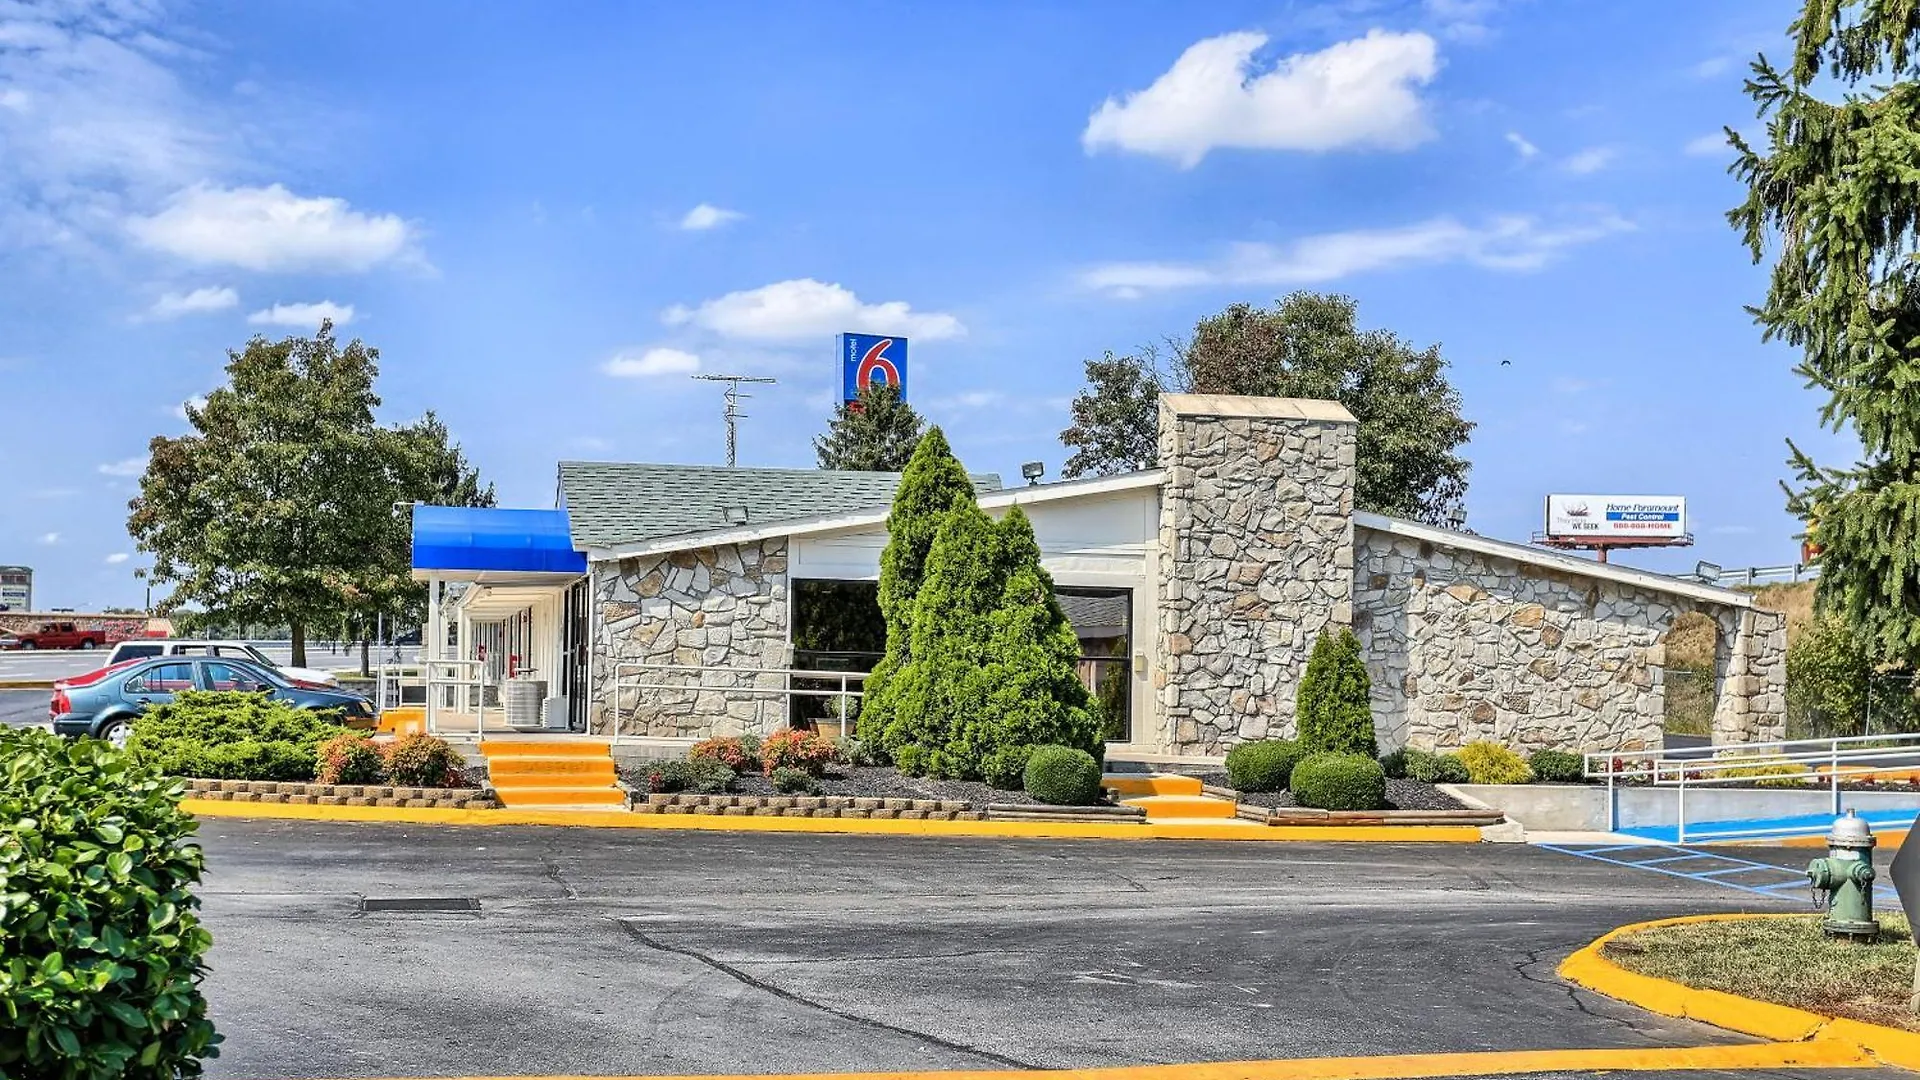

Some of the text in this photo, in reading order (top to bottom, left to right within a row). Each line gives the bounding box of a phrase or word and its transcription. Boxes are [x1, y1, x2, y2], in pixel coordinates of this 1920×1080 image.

[856, 339, 900, 394] 6
[1606, 503, 1679, 511] Home Paramount
[1621, 513, 1665, 521] Pest Control
